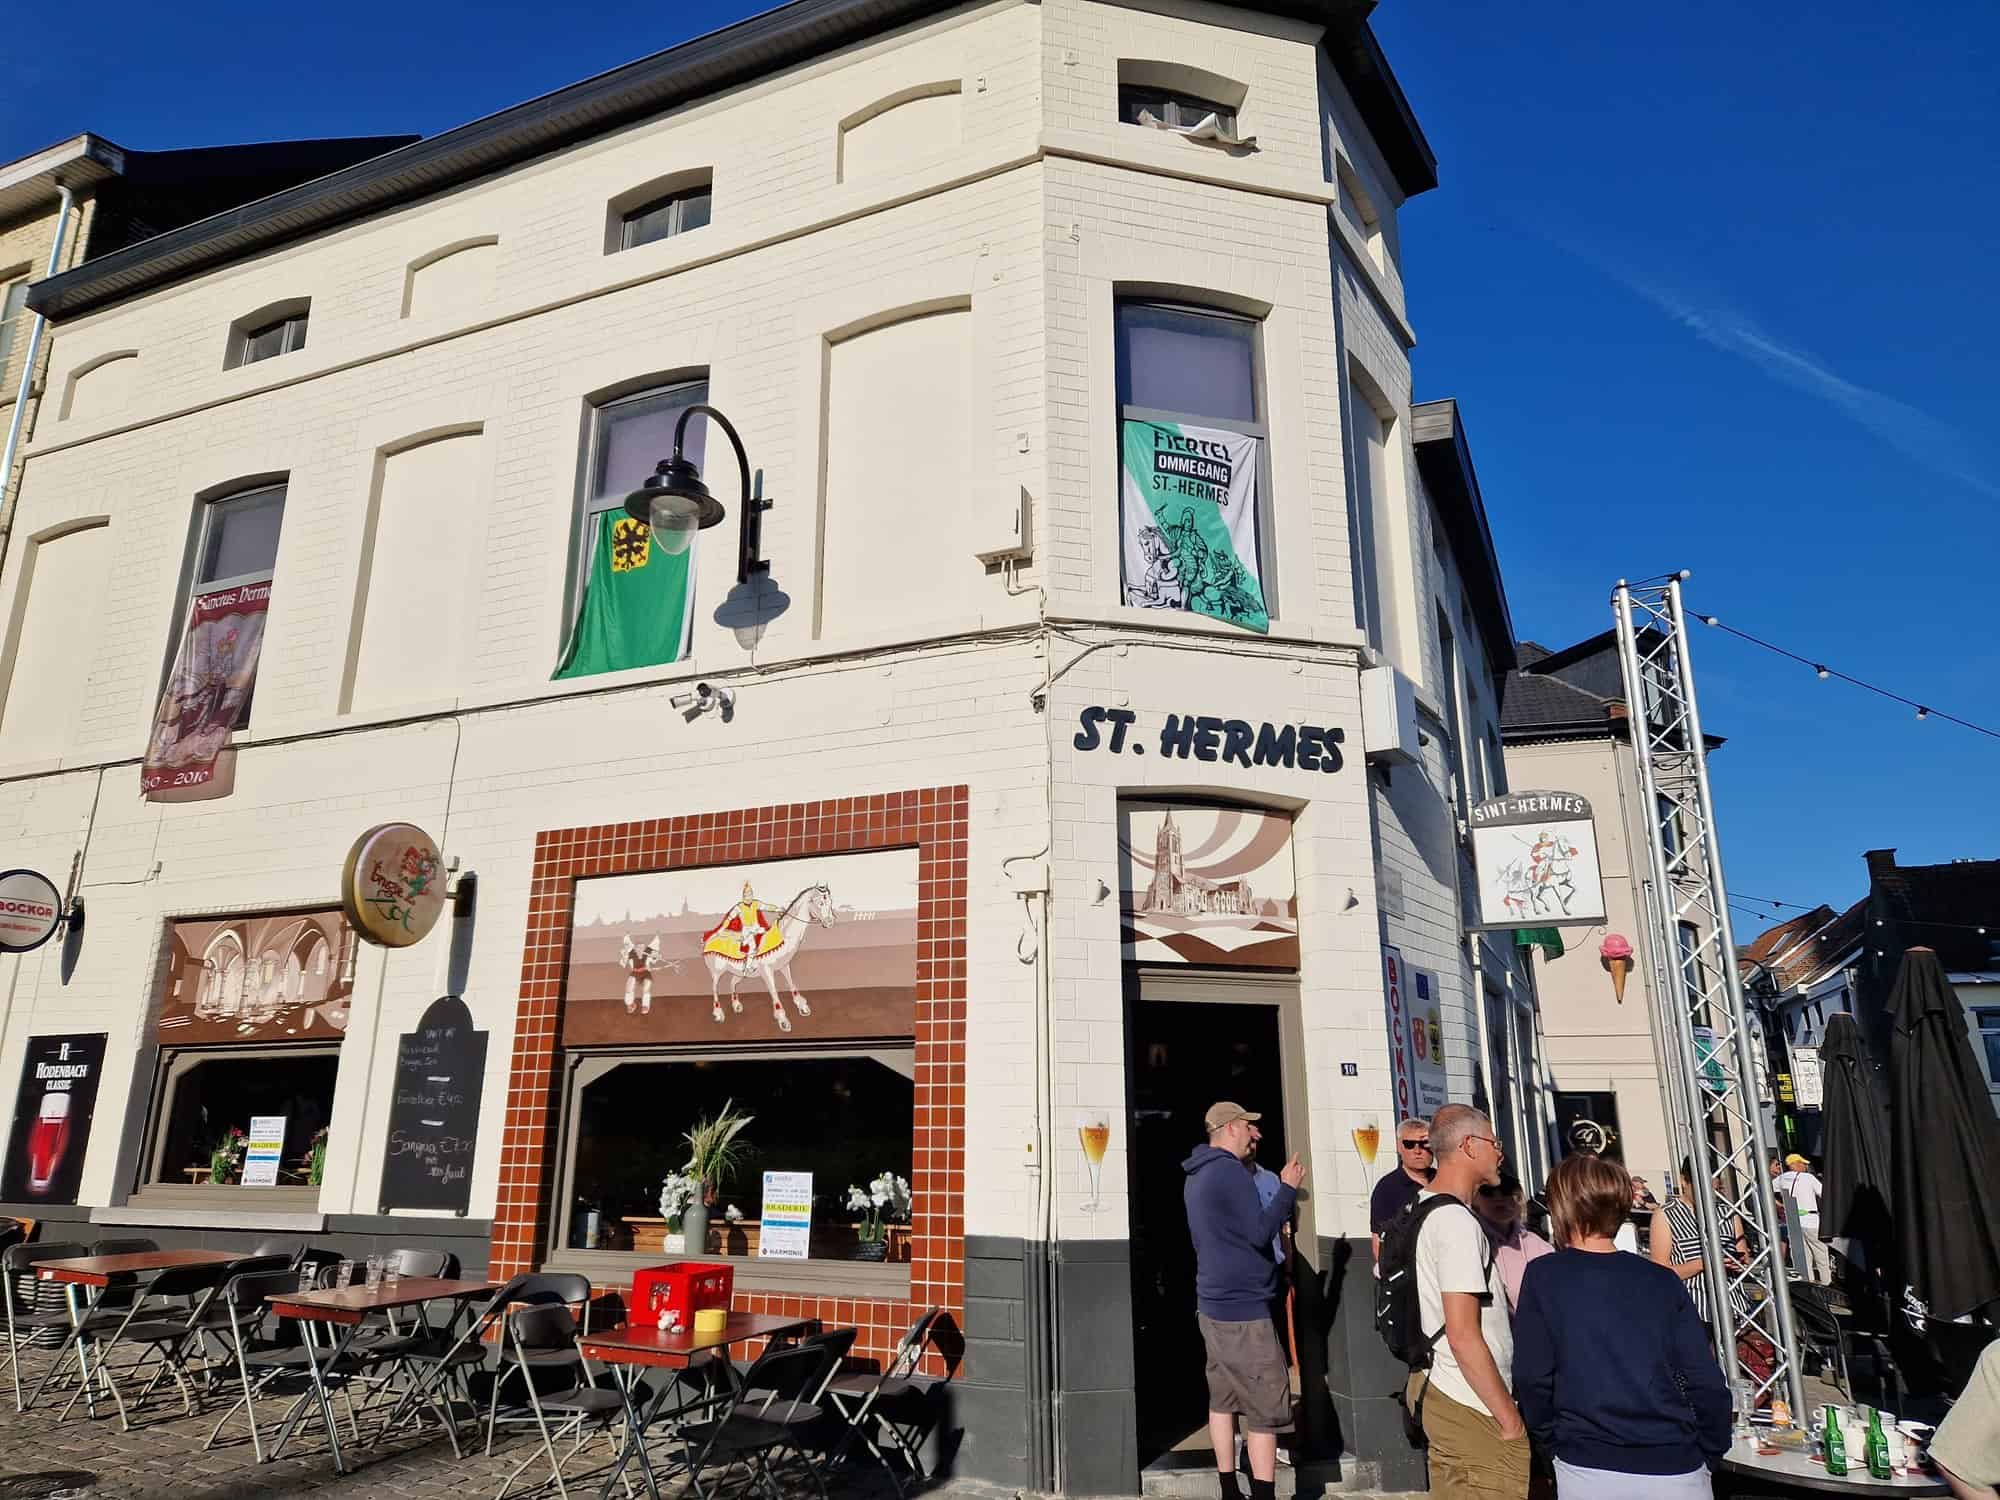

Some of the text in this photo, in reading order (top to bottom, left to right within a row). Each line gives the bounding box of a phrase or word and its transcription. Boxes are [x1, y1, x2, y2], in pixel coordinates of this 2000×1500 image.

[1153, 430, 1233, 463] FIERTEL
[1157, 453, 1229, 483] OMMEGANG
[1152, 474, 1230, 507] ST.-HERMES
[1073, 705, 1346, 775] ST. HERMES
[173, 771, 209, 785] 2010
